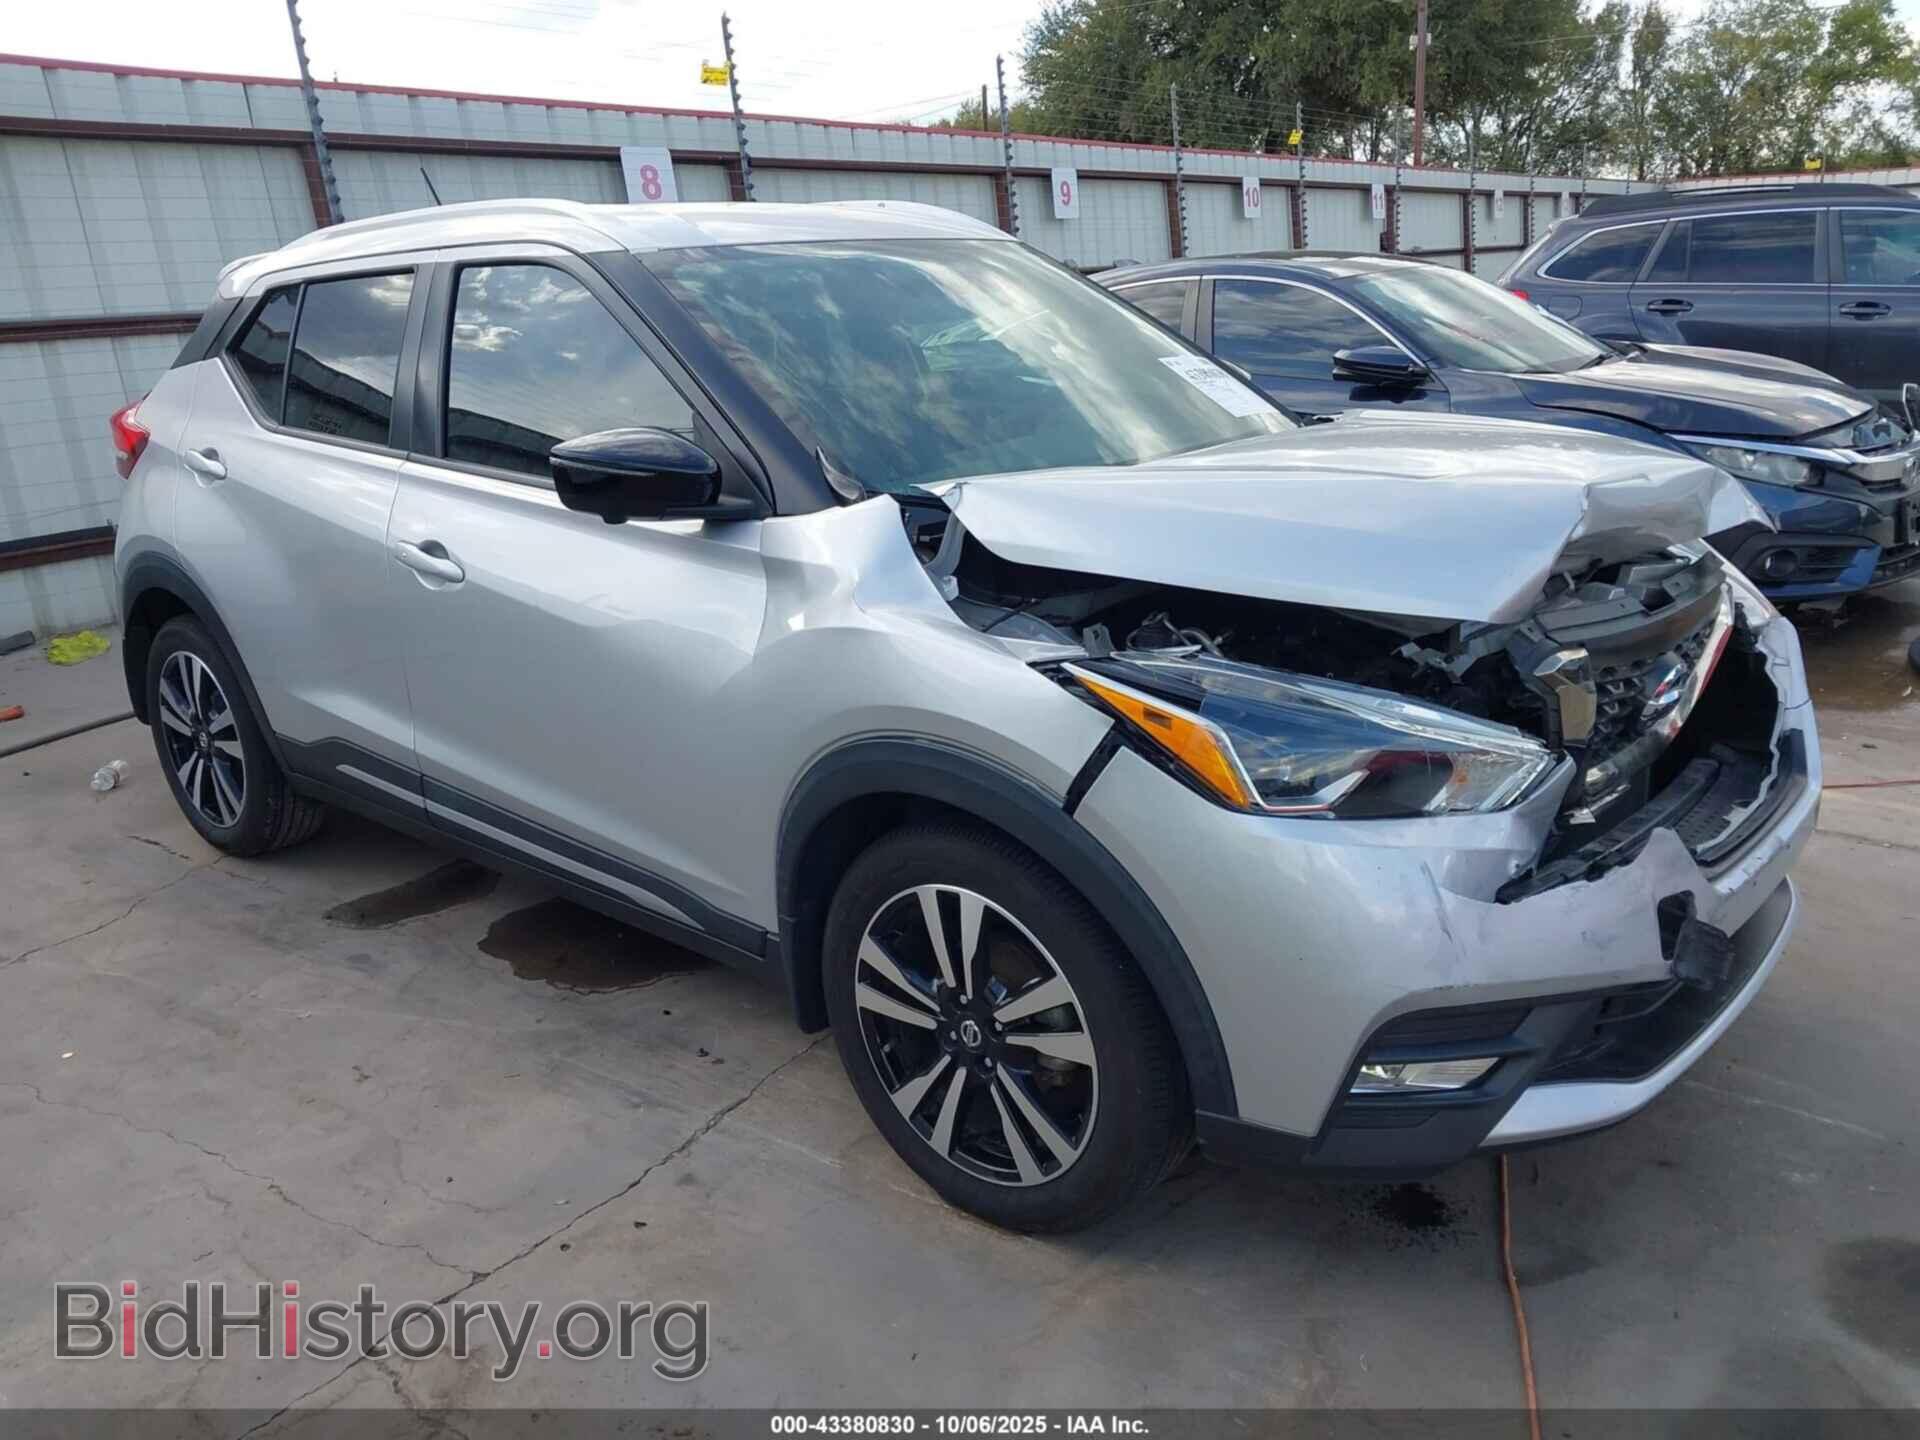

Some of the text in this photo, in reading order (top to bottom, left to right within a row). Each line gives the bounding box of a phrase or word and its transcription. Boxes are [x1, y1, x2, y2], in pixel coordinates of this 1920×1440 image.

[640, 164, 662, 200] 8
[1060, 180, 1072, 206] 9
[1245, 186, 1260, 208] 10
[1373, 192, 1384, 209] 11
